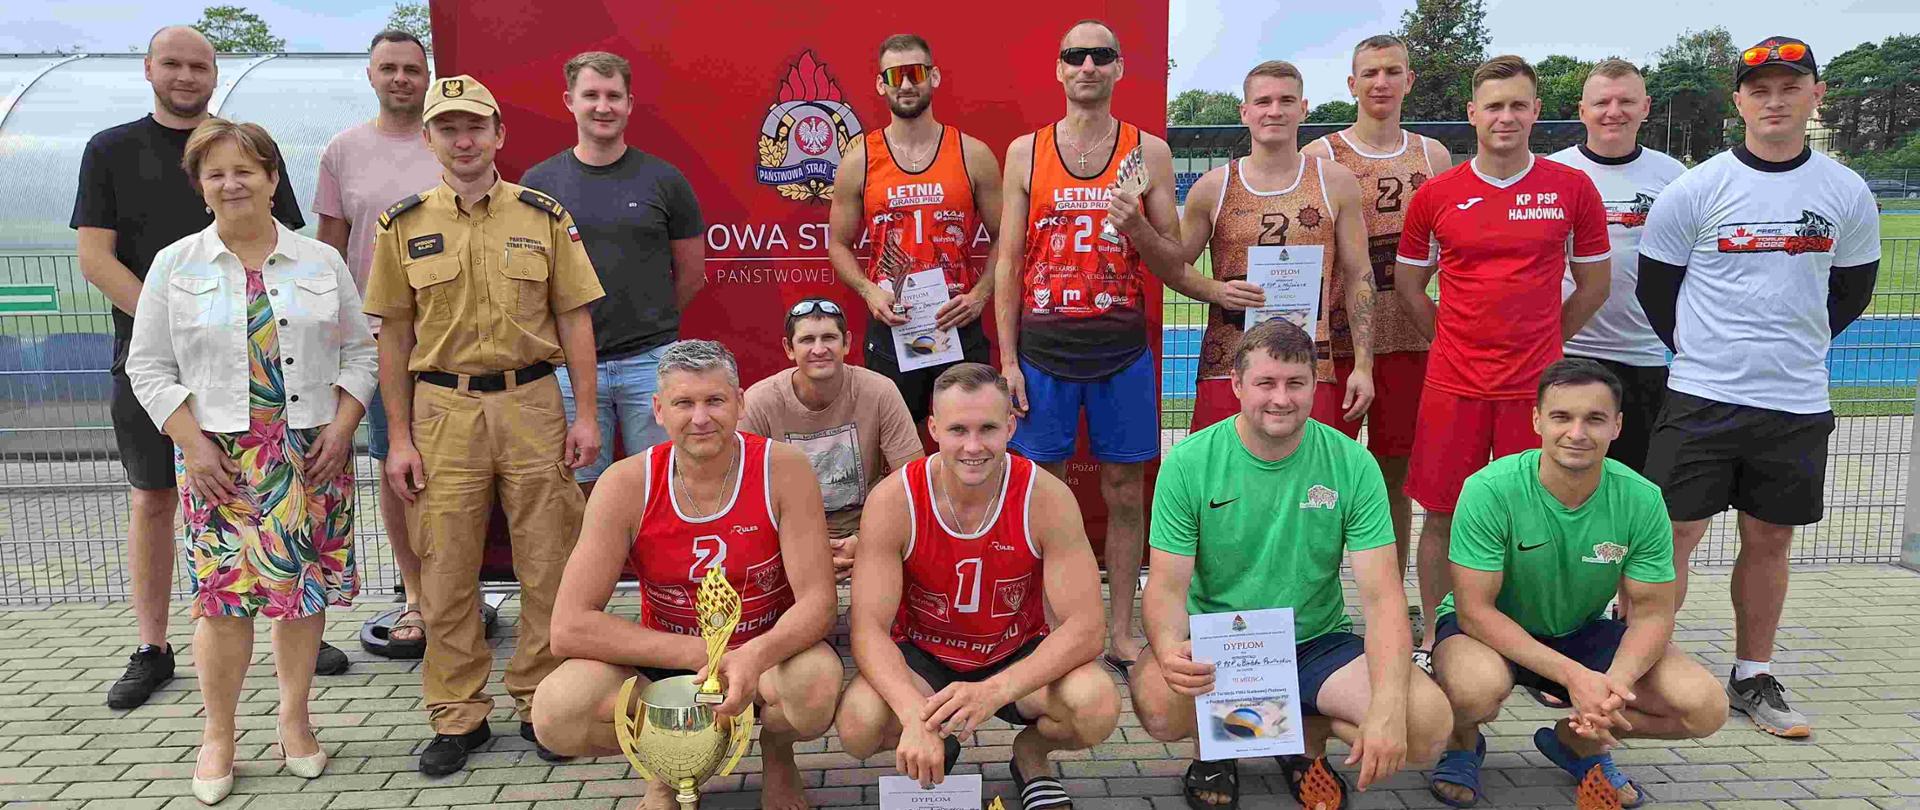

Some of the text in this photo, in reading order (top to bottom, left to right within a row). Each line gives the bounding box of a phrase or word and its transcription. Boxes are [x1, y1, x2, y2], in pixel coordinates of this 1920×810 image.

[759, 165, 804, 182] PAŃSTWOWA
[806, 162, 827, 177] STRAŻ
[887, 182, 944, 200] LETNIA
[1053, 187, 1113, 202] LETNIA
[1376, 176, 1403, 213] 2
[1516, 192, 1558, 206] KP PSP
[891, 196, 941, 208] GRAND PRIX
[1058, 201, 1110, 209] GRAND PRIX
[1508, 206, 1565, 220] HAJNÓWKA
[707, 223, 789, 250] OWA
[914, 209, 923, 244] 1
[1074, 215, 1092, 253] 2
[1258, 213, 1290, 246] 2
[717, 265, 836, 285] PAŃSTWOWEJ
[688, 535, 728, 584] 2
[954, 556, 983, 613] 1
[735, 608, 778, 634] ACHU
[908, 627, 941, 643] LATO
[945, 639, 967, 649] NA
[1224, 640, 1264, 651] DYPLOM
